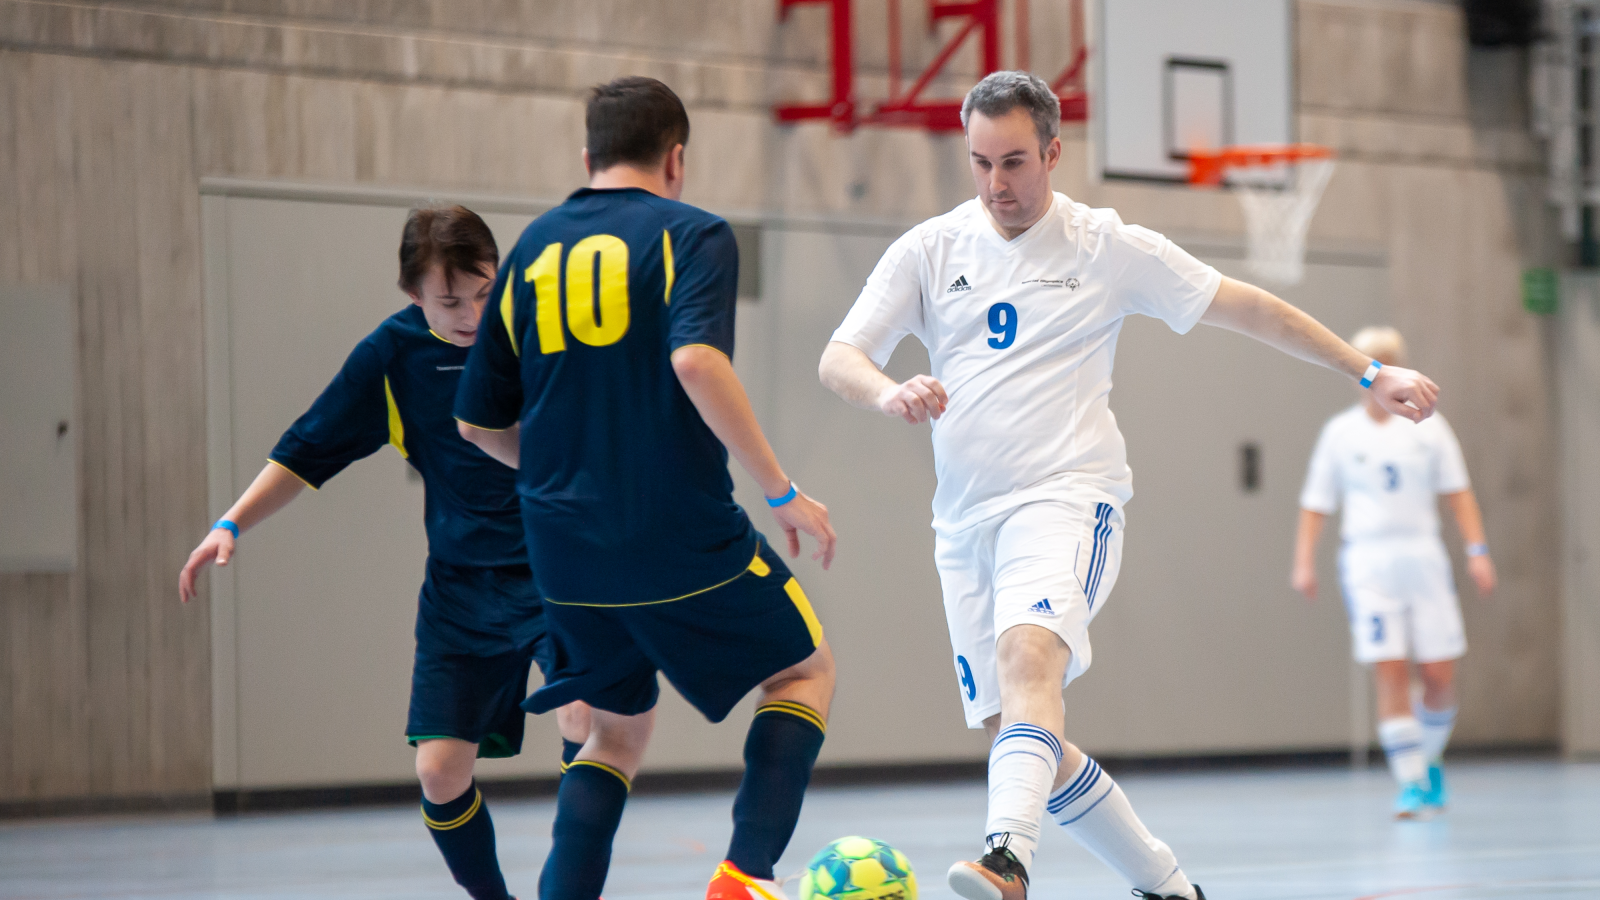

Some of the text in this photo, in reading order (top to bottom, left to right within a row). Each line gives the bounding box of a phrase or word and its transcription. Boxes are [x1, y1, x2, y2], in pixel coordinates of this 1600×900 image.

[525, 234, 631, 354] 10
[987, 302, 1018, 350] 9
[957, 655, 976, 701] 9
